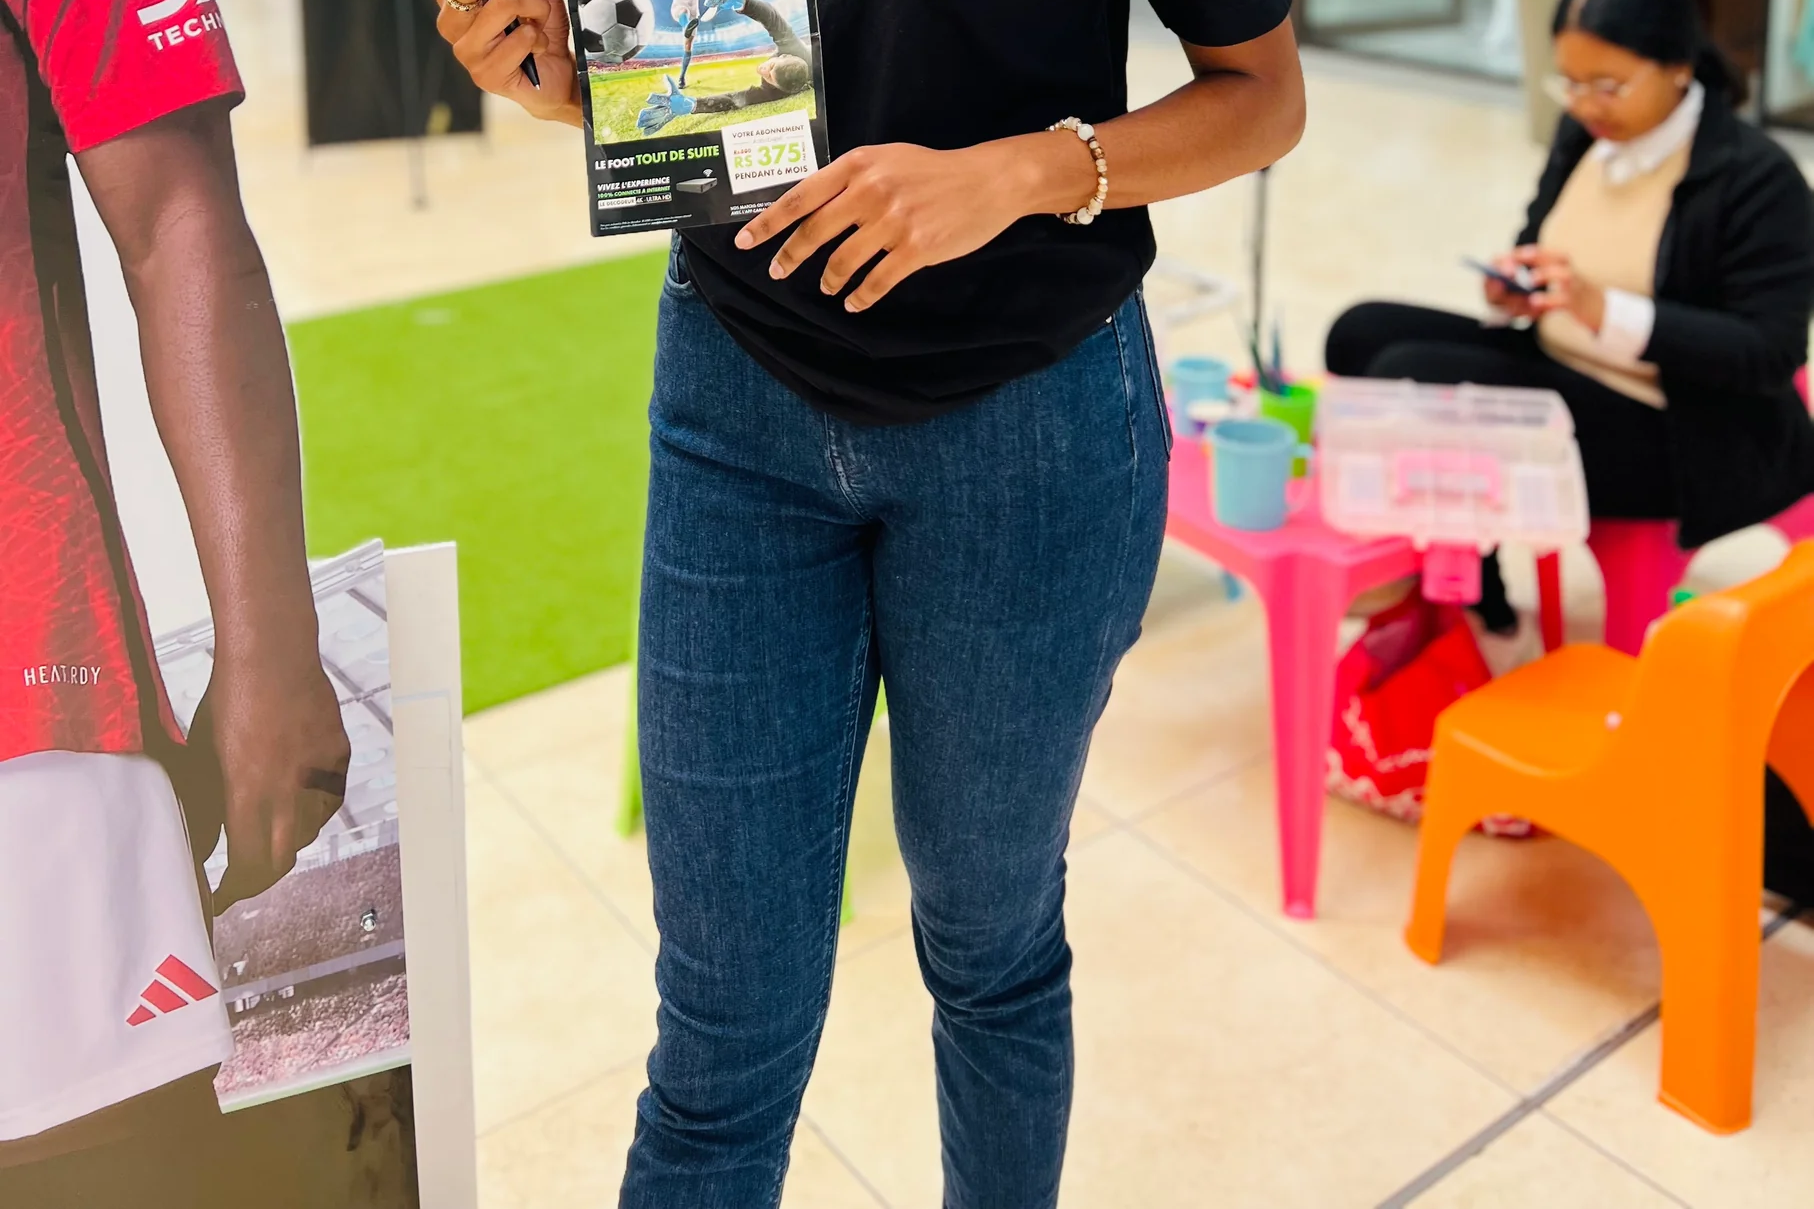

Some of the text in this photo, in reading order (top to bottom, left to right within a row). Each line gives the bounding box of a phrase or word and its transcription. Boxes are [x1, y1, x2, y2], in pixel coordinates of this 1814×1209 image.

[756, 125, 804, 136] ABONNEMENT
[595, 160, 607, 170] LE
[607, 157, 635, 169] FOOT
[636, 151, 667, 165] TOUT
[669, 150, 685, 161] DE
[687, 145, 720, 159] SUITE
[733, 155, 753, 168] RS
[756, 142, 802, 166] 375
[735, 165, 808, 180] PENDANT 6 MOIS
[597, 182, 620, 192] VIVEZ
